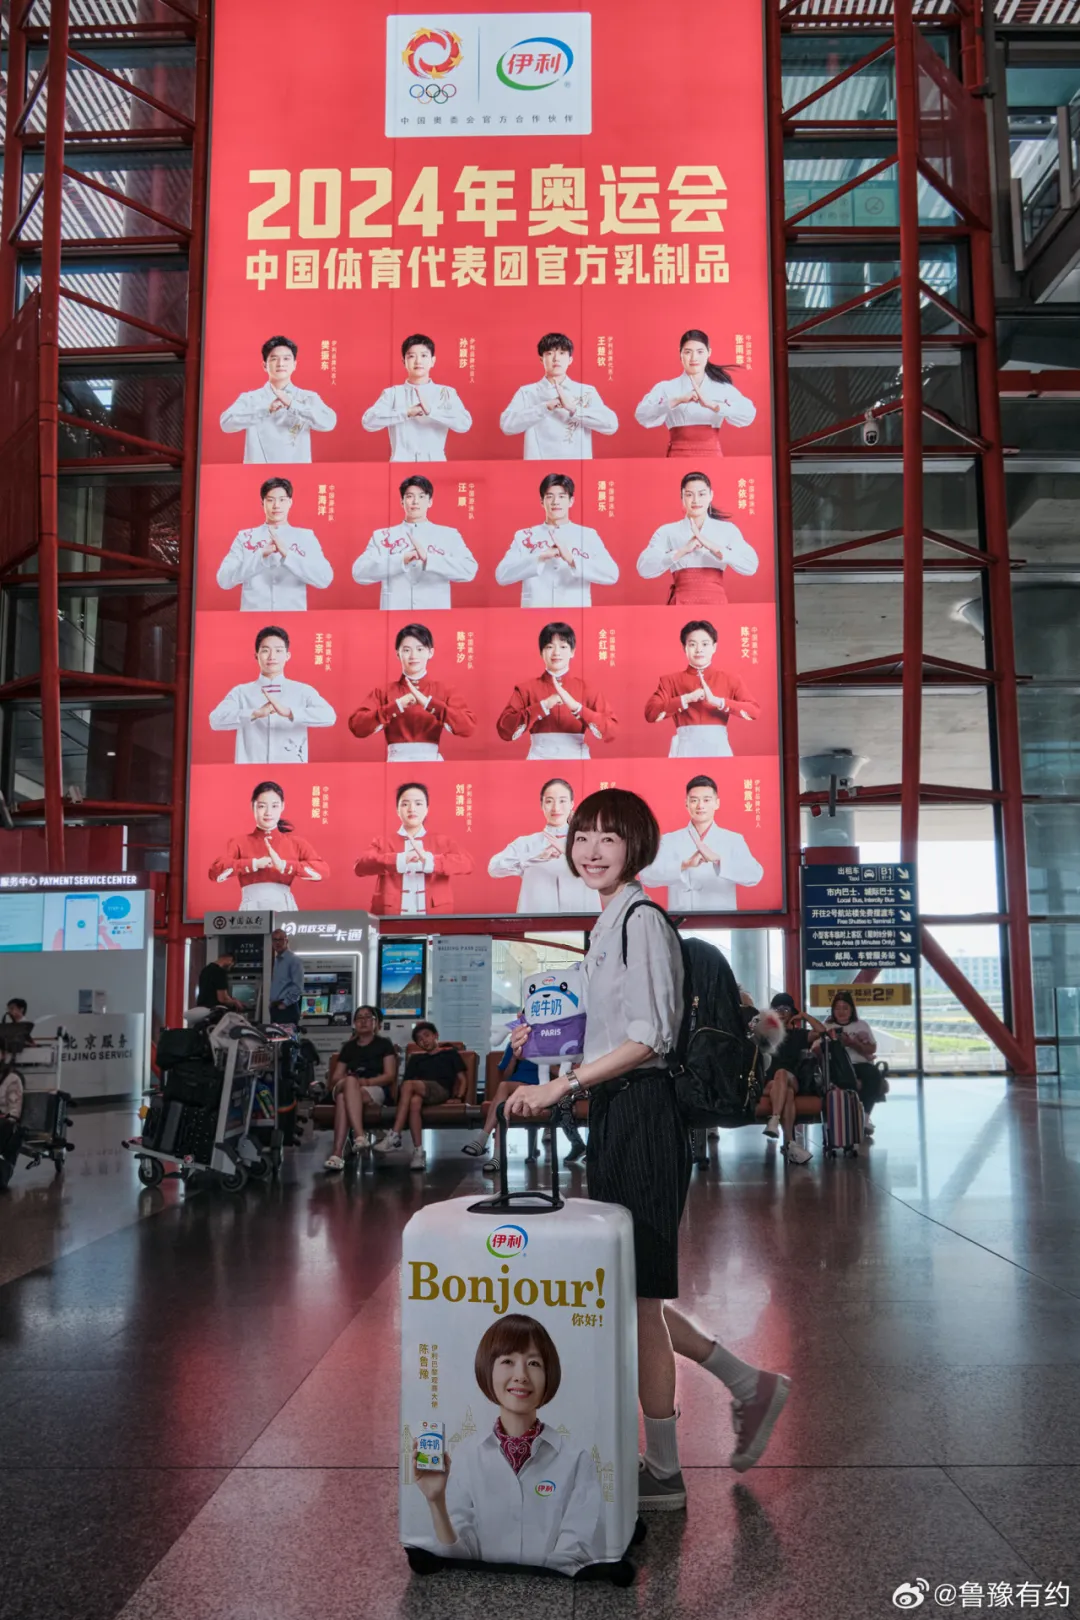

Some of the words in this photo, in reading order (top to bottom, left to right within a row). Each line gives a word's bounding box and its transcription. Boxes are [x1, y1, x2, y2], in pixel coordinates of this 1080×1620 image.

[507, 52, 562, 76] 伊利
[400, 114, 574, 125] 中国奥委会官方合作伙伴
[247, 164, 729, 241] 2024年奥运会
[246, 243, 730, 290] 中国体育代表团官方乳制品
[315, 633, 324, 665] 王宗源
[456, 631, 465, 663] 陈芋汐
[599, 629, 607, 661] 全红婵
[741, 626, 750, 658] 陈艺文
[838, 867, 860, 875] 出租车
[881, 867, 892, 875] B1
[39, 876, 74, 885] PAYMENT
[74, 875, 106, 885] SERVICE
[107, 875, 137, 885] CENTER
[826, 888, 895, 896] 市内巴士、城际巴士
[298, 924, 337, 934] 市政交通
[320, 929, 363, 942] 一卡通
[531, 999, 562, 1017] 纯牛奶
[541, 1029, 561, 1037] PARIS
[61, 1053, 97, 1062] EIJING
[492, 1234, 523, 1249] 伊利
[408, 1261, 606, 1315] Bonjour!
[419, 1344, 430, 1380] 陈鲁豫
[419, 1439, 440, 1450] 纯牛奶
[537, 1485, 553, 1493] 伊利
